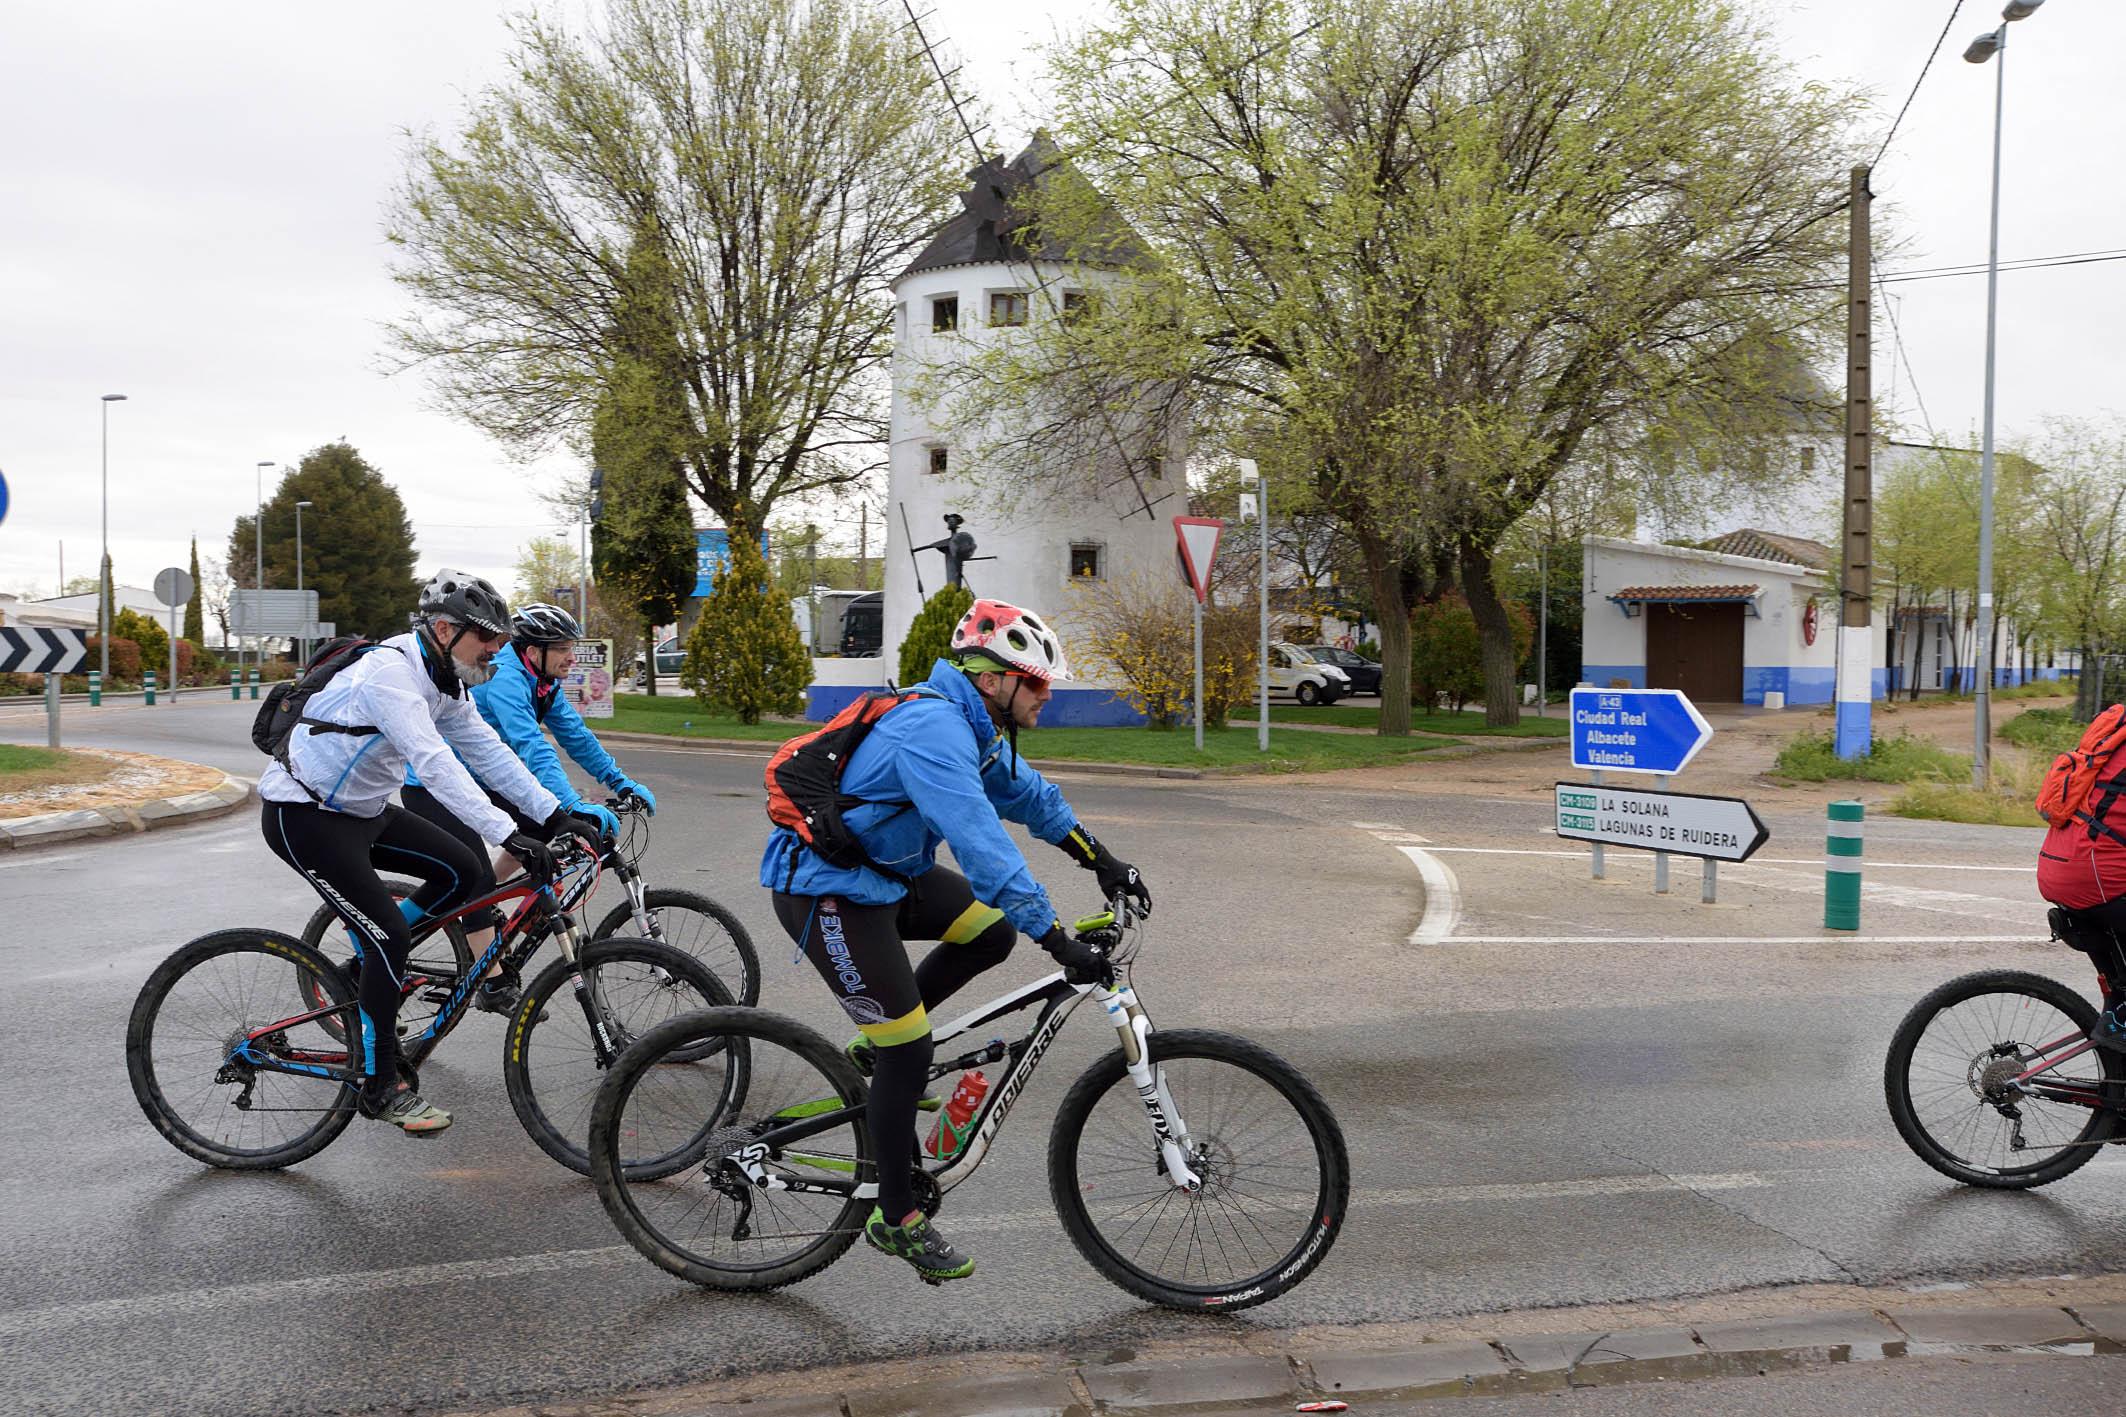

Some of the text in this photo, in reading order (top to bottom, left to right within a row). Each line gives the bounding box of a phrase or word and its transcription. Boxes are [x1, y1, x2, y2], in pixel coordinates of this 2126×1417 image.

[575, 646, 598, 655] ERIA
[1601, 696, 1621, 707] A-43
[1576, 709, 1648, 726] Ciudad Real
[1586, 730, 1637, 746] Albacete
[1587, 749, 1636, 766] Valencia
[1601, 798, 1615, 812] LA
[1622, 800, 1670, 818] SOLANA
[1600, 819, 1653, 838] LAGUNAS
[1660, 826, 1676, 841] DE
[1682, 829, 1739, 849] RUIDERA
[307, 869, 390, 940] LAPIERRE
[819, 915, 867, 994] TOMBIKE
[512, 997, 536, 1064] MAXXIS
[981, 1009, 1063, 1145] LAPIERRE
[1145, 1100, 1174, 1141] FOX
[1222, 1286, 1265, 1304] TAIPAN
